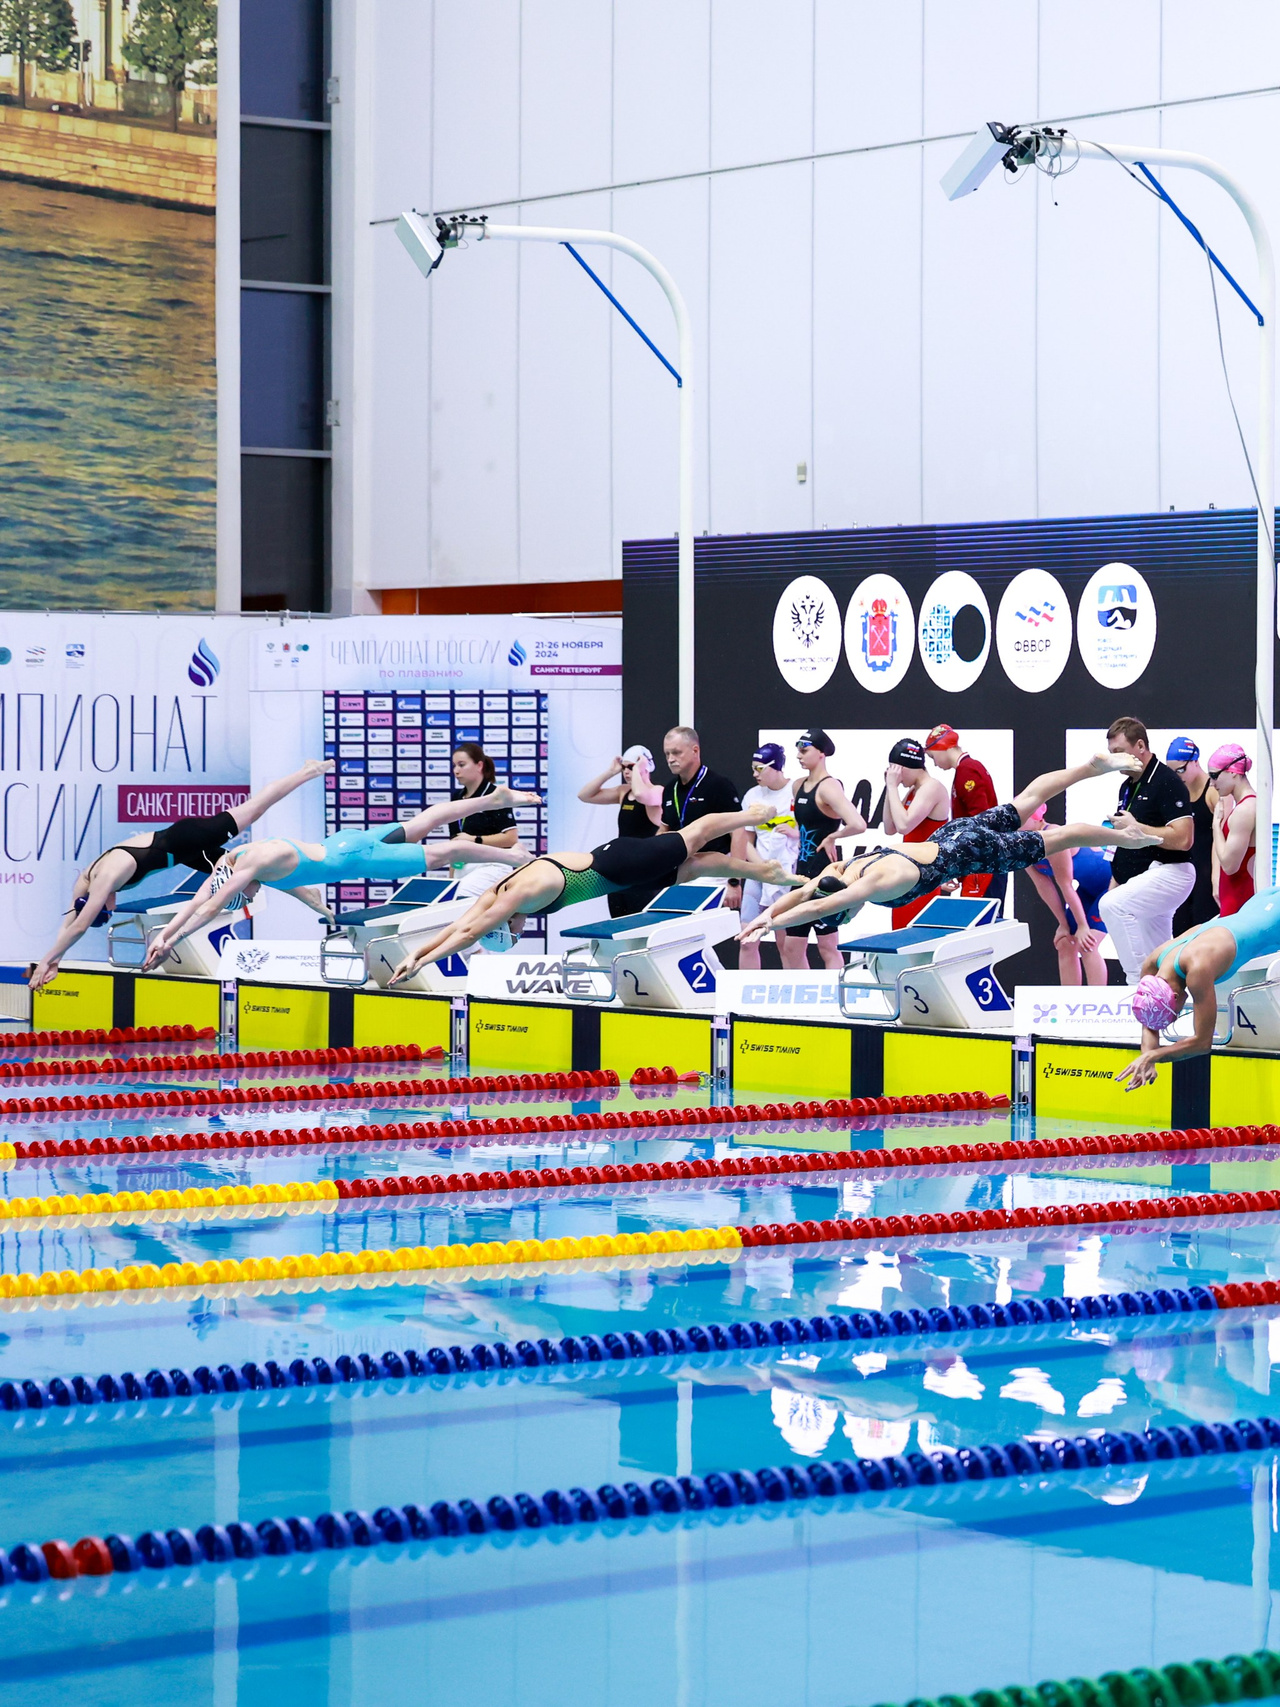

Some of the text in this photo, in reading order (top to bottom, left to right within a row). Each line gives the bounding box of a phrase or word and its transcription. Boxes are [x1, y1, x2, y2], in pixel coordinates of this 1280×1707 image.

[535, 641, 604, 649] 21-26 НОЯБРЯ
[535, 650, 559, 658] 2024
[379, 669, 464, 678] по плаванию
[534, 666, 603, 674] САНКТ-ПЕТЕРБУРГ
[0, 693, 218, 774] ПИОНАТ
[127, 792, 251, 817] САНКТ-ПЕТЕРБУР
[623, 969, 649, 996] 2
[692, 962, 707, 989] 2
[505, 979, 592, 994] WAVE
[741, 983, 871, 1005] СИБУР
[977, 977, 994, 1005] 3
[904, 985, 930, 1014] 3
[483, 1022, 528, 1034] SWISS TIMING
[1236, 1005, 1258, 1036] 4
[750, 1043, 801, 1055] SWISS TIMING
[1054, 1067, 1113, 1080] SWISS TIMING
